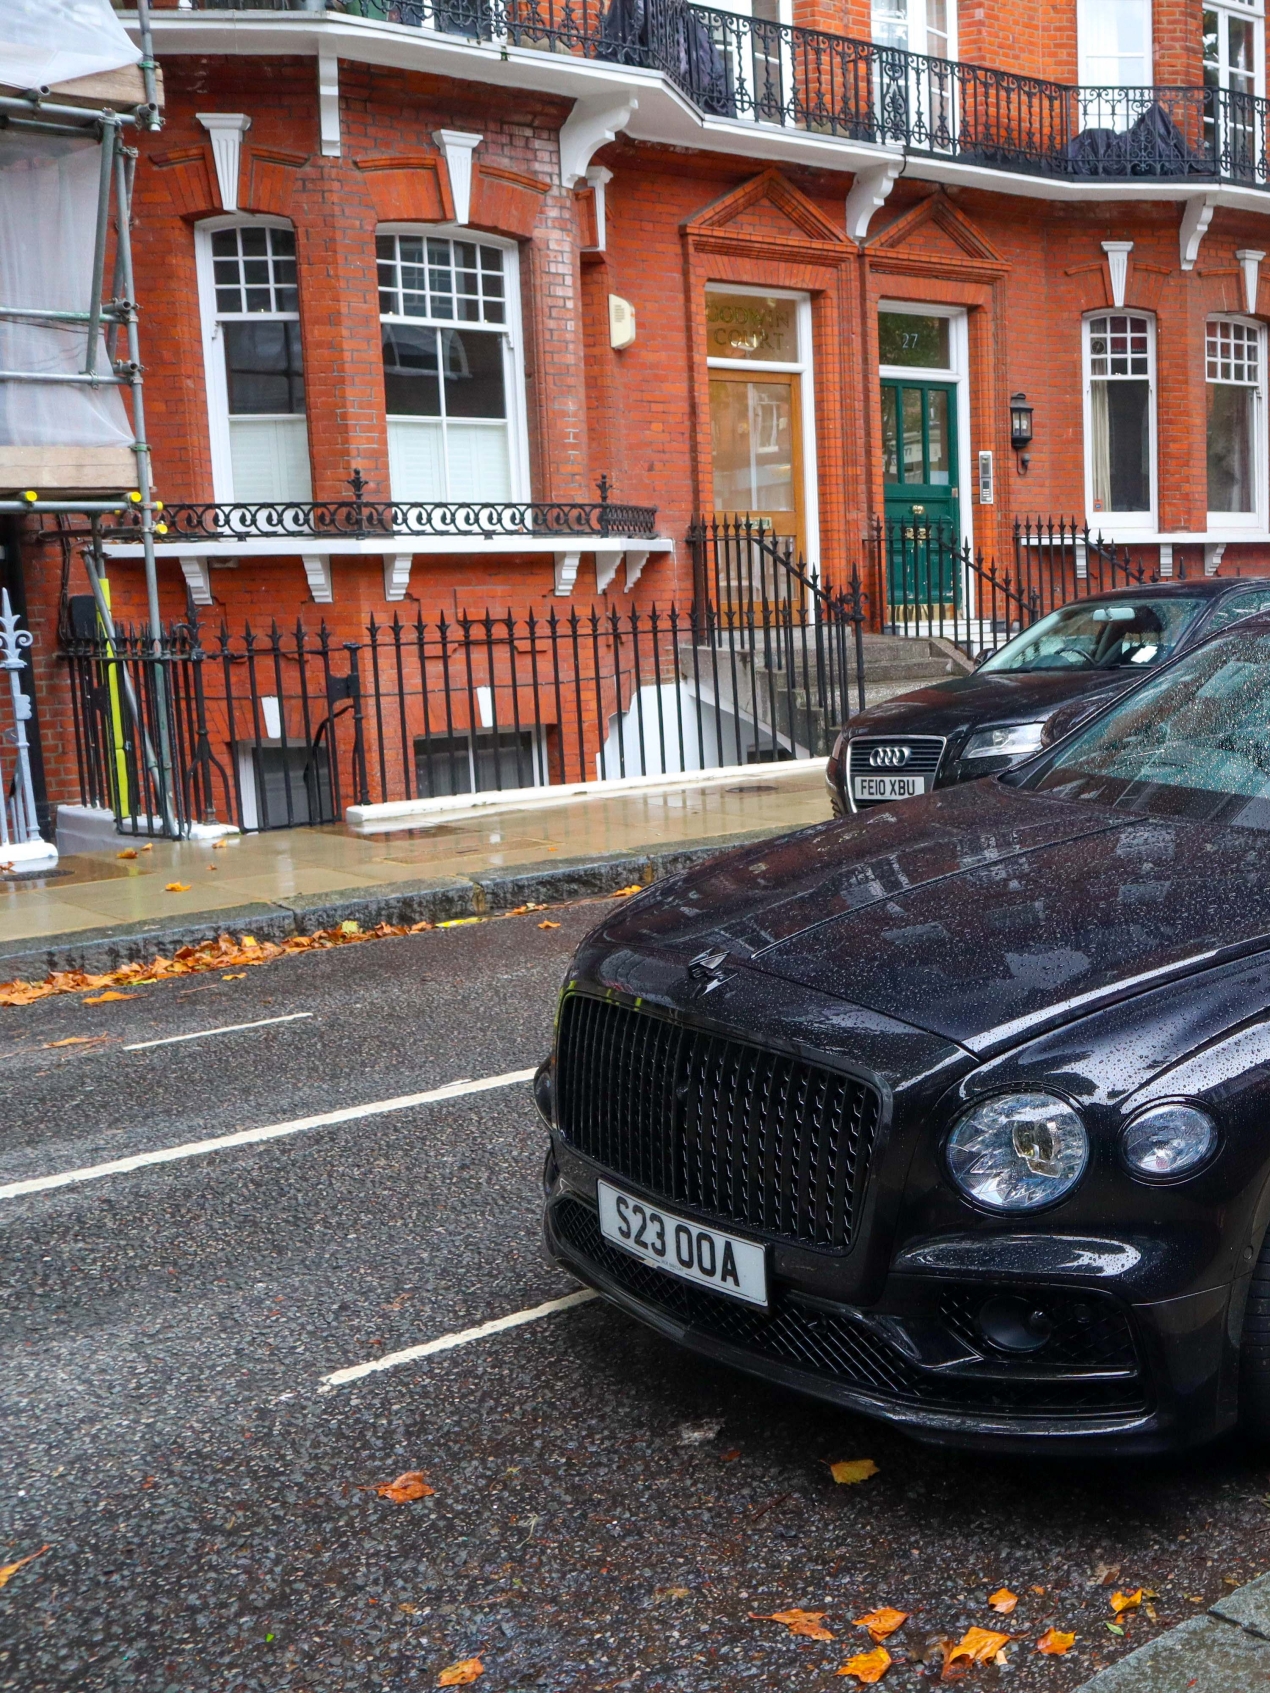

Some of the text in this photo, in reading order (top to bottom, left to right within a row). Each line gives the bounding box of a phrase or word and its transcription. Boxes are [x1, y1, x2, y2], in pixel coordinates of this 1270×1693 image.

[902, 332, 919, 349] 27
[860, 779, 916, 796] FE10 XBU
[616, 1195, 666, 1258] S23
